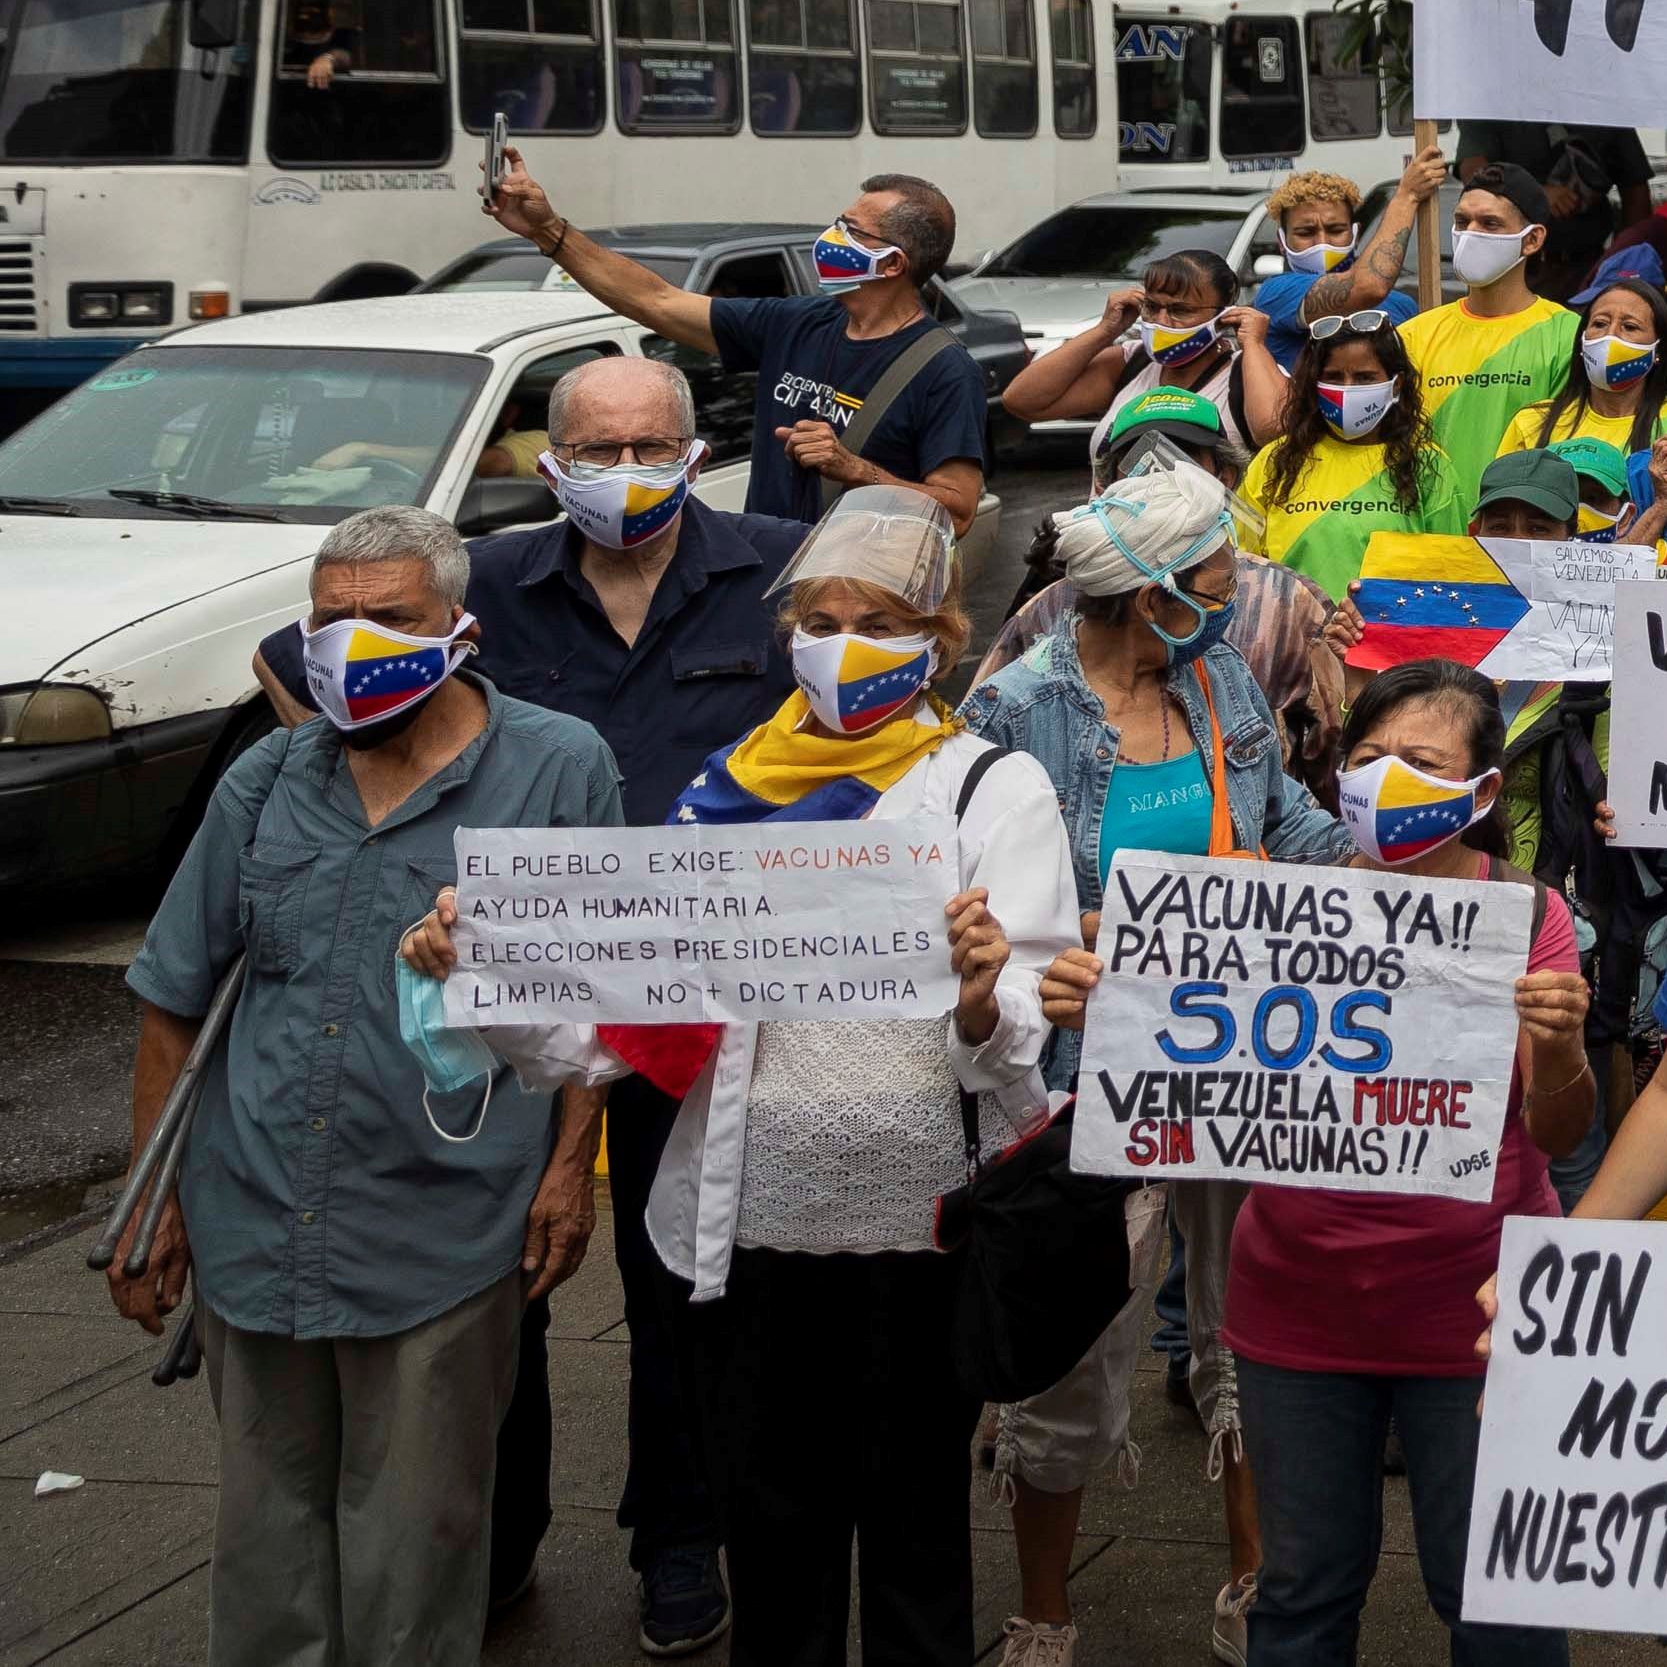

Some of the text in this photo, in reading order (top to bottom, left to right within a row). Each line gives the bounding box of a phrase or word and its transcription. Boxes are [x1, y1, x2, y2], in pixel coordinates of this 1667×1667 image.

[1428, 370, 1532, 389] convergencia
[564, 492, 609, 525] VACUNAS
[576, 513, 593, 531] YA
[1555, 546, 1634, 566] SALVEMOS A
[1567, 632, 1610, 669] YA
[466, 843, 943, 878] EL PUEBLO EXIGE: VACUNAS YA
[472, 894, 780, 920] AYUDA HUMANITARIA.
[1115, 868, 1481, 953] VACUNAS YA!!
[472, 931, 931, 964] ELECCIONES PRESIDENCIALES
[1110, 923, 1407, 990] PARA TODOS
[473, 977, 919, 1010] LIMPIAS. NO + DICTADURA
[1154, 980, 1394, 1074] S.O.S
[1097, 1069, 1473, 1130] VENEZUELA MUERE
[1124, 1117, 1196, 1166] SIN
[1449, 1148, 1492, 1179] UDSE
[1512, 1241, 1653, 1359] SIN
